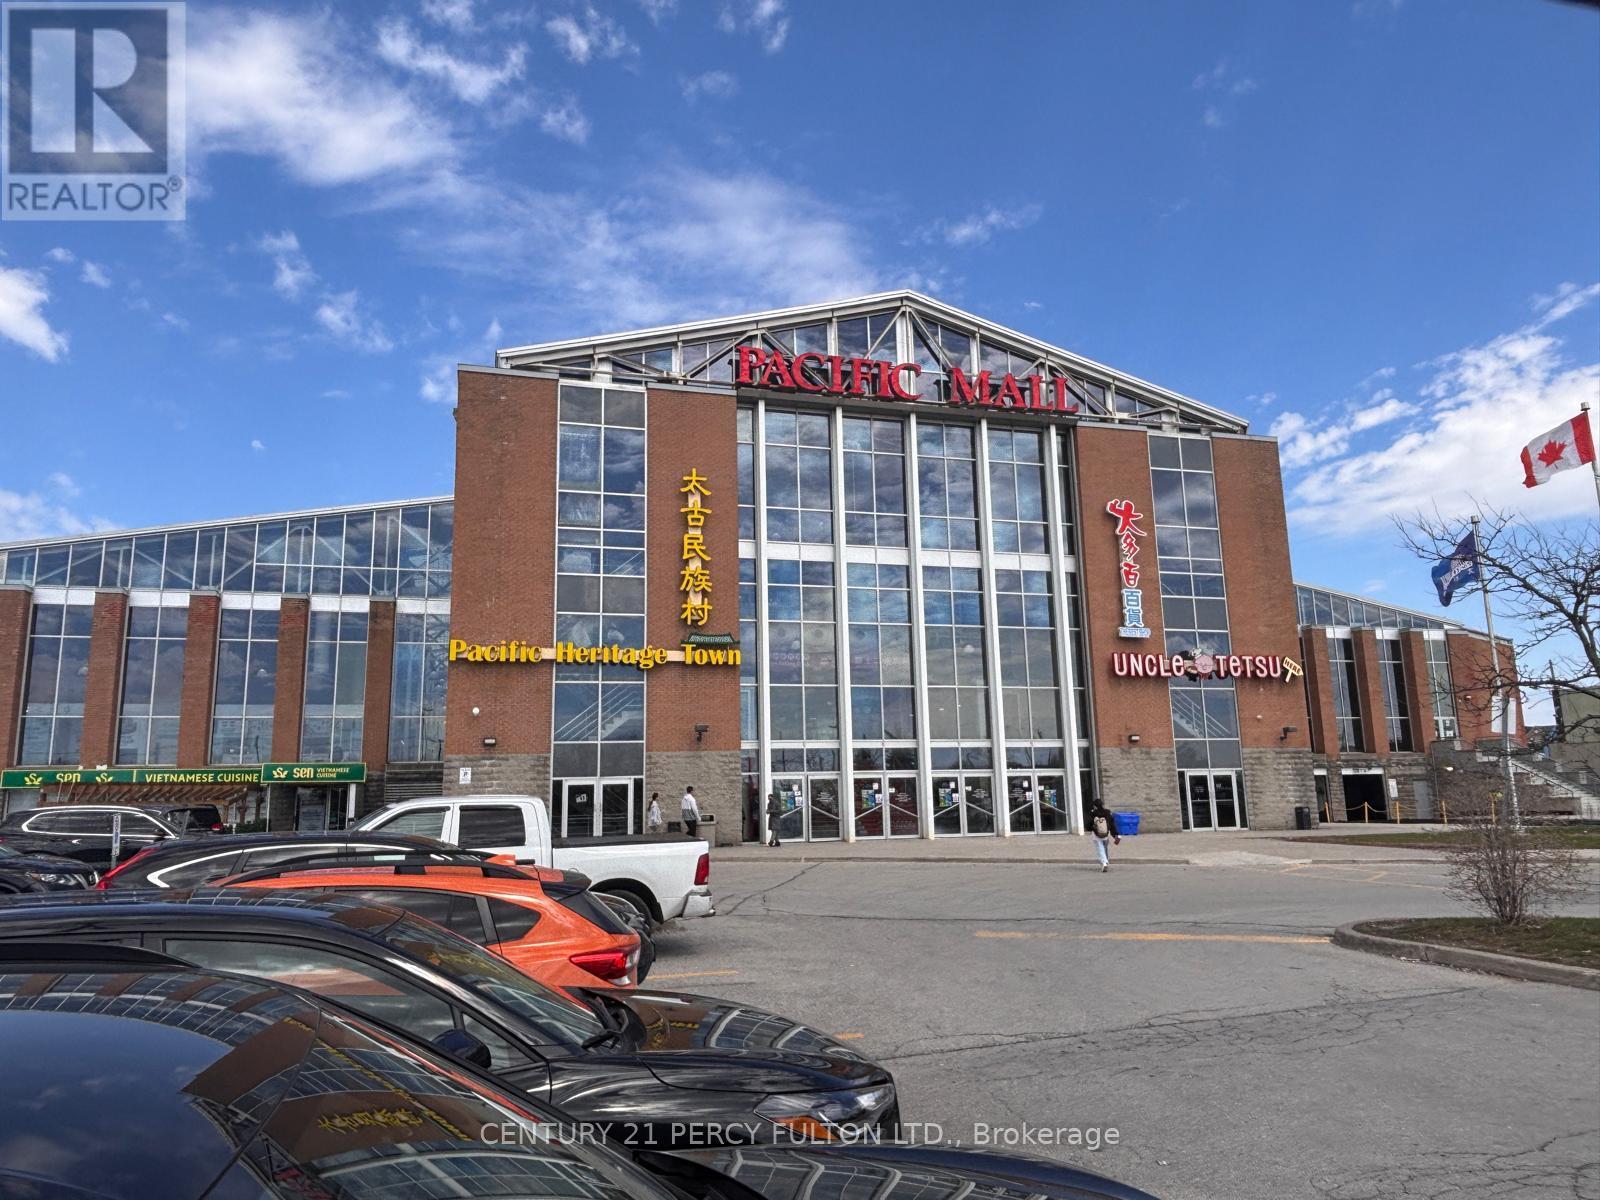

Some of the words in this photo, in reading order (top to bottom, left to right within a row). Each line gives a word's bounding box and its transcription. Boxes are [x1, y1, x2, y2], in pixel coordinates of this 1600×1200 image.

[734, 345, 923, 401] PACIFIC
[948, 367, 1079, 414] MALL
[680, 467, 713, 626] 太古民族村
[449, 638, 543, 663] Pacific
[555, 641, 668, 670] Heritage
[681, 643, 741, 666] Town
[145, 773, 214, 783] VIETNAMESE
[217, 773, 259, 783] CUISINE
[293, 767, 314, 778] sen
